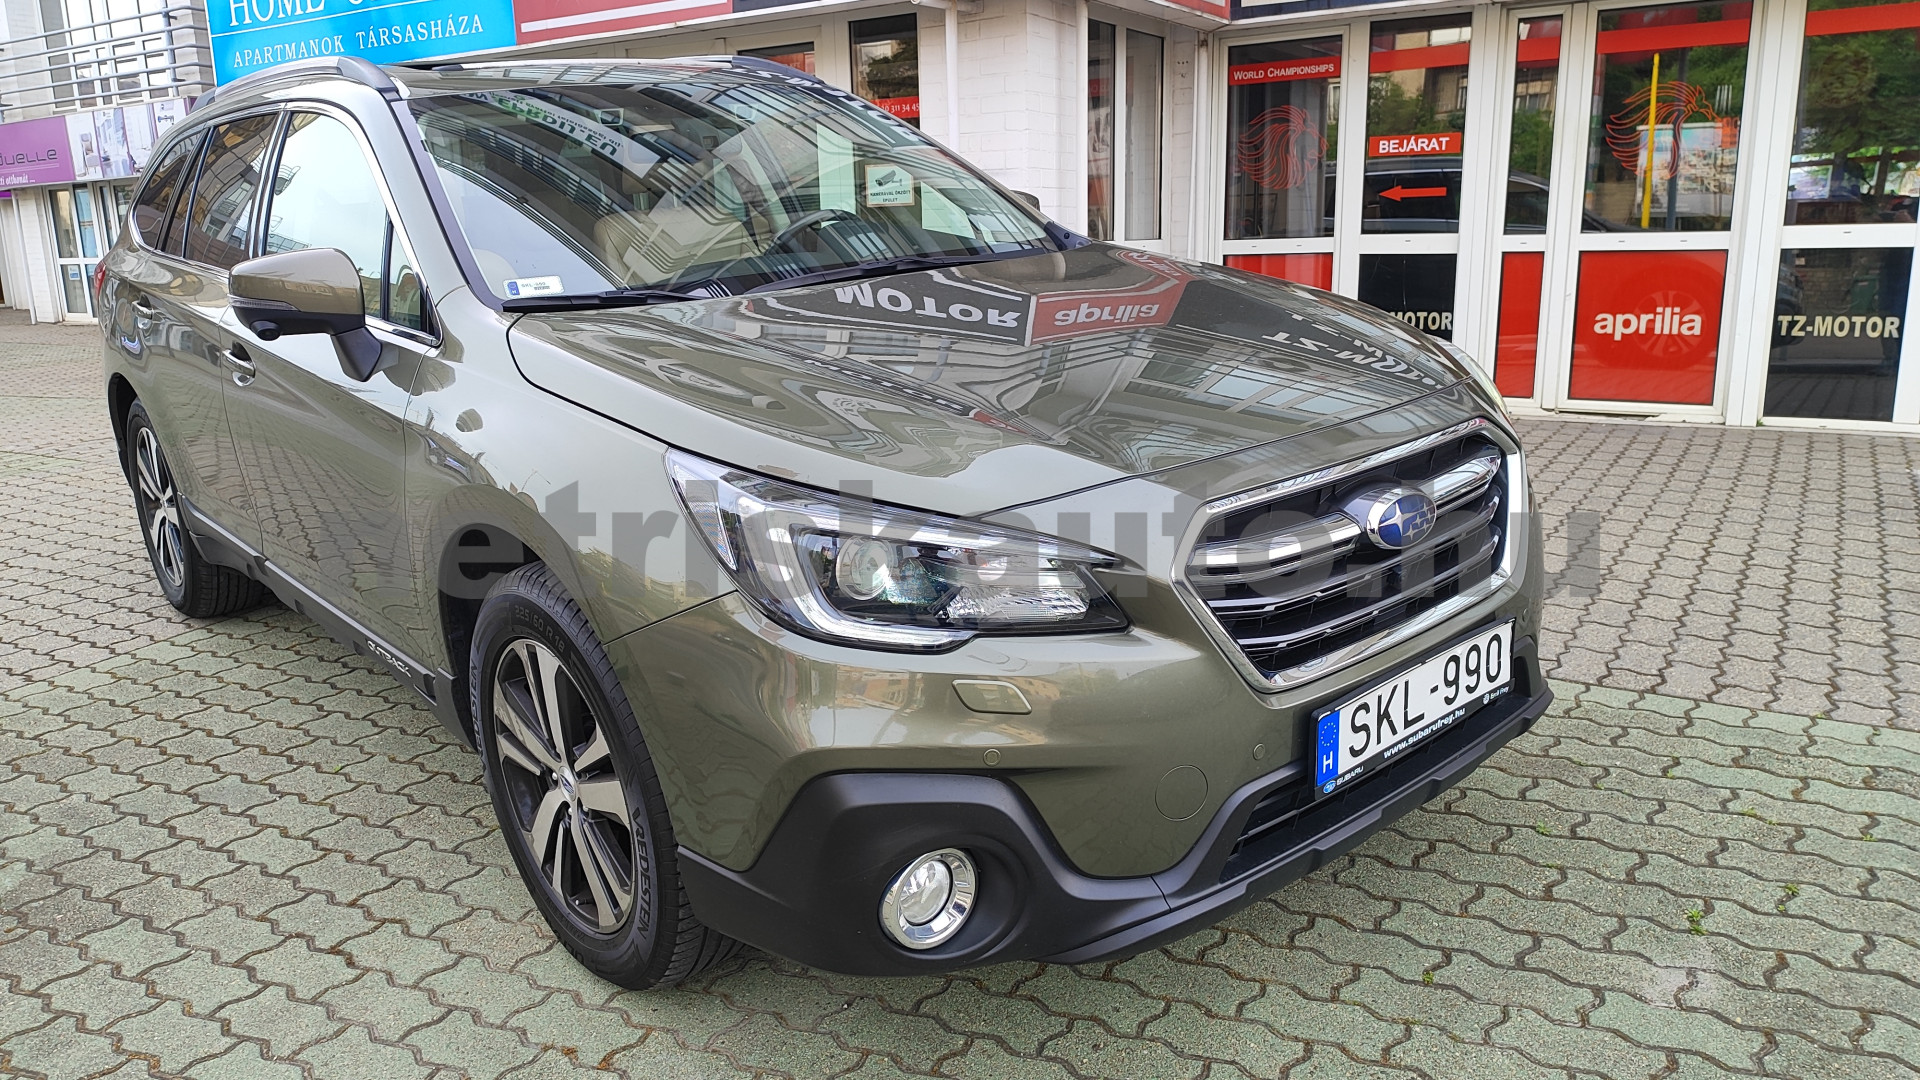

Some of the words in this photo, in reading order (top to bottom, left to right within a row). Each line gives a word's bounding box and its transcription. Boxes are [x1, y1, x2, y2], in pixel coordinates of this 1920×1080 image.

[233, 35, 345, 68] APARTMANOK
[355, 14, 484, 49] TÁRSASHÁZA
[1378, 136, 1450, 154] BEJÁRAT
[1593, 307, 1702, 341] aprilia
[1777, 315, 1900, 339] TZ-MOTOR
[1348, 633, 1502, 758] SKL-990
[1383, 708, 1466, 759] www.subarufrey.hu
[1322, 750, 1333, 774] H
[631, 807, 651, 941] VREDESTEIN
